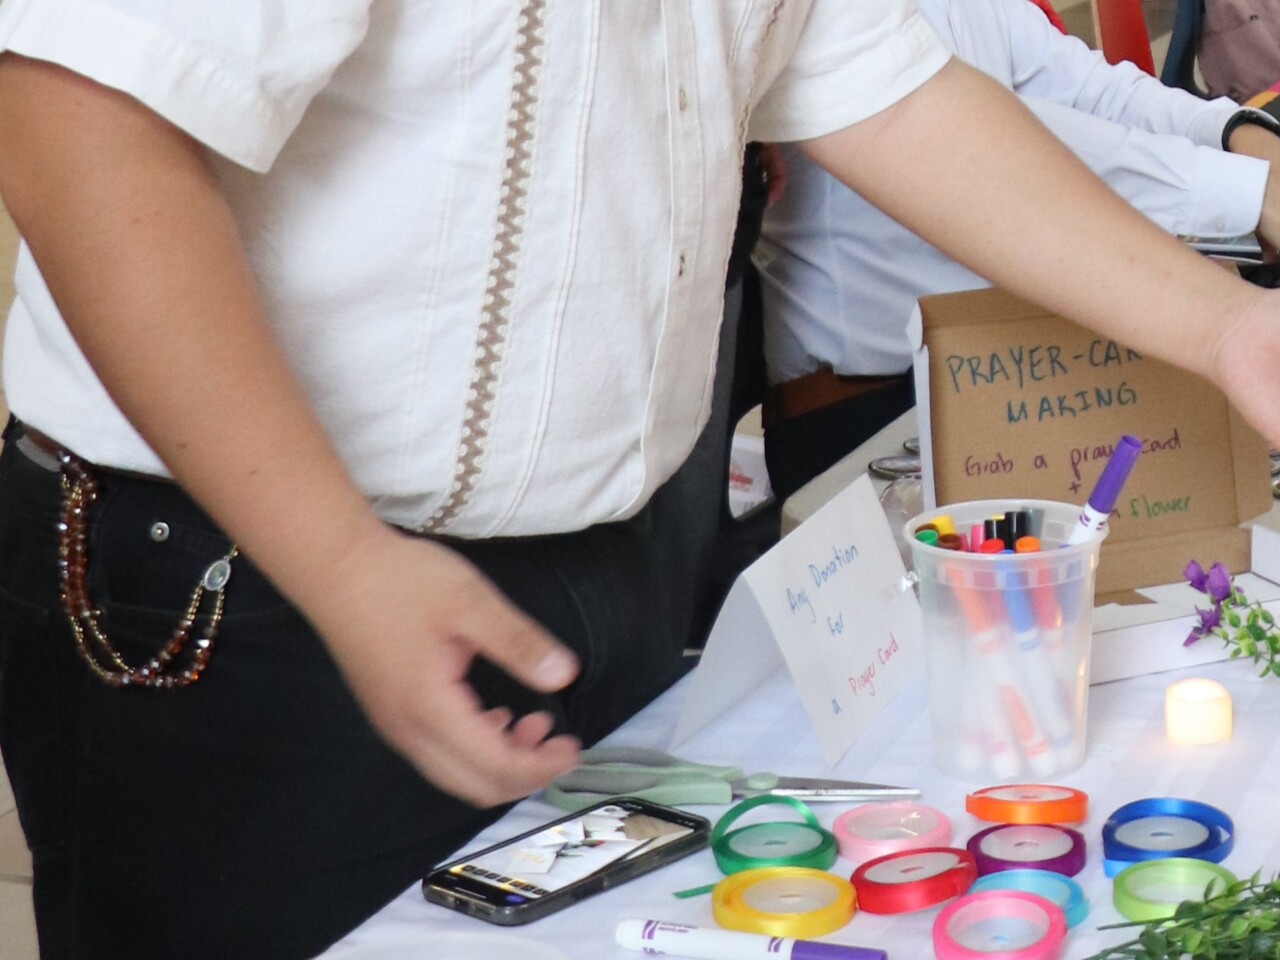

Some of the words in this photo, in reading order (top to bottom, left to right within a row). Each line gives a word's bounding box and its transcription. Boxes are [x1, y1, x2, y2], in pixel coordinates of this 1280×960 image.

[1007, 382, 1137, 423] MAKING
[965, 453, 1014, 476] Grab
[1034, 454, 1047, 469] a
[1130, 494, 1190, 518] flower
[787, 588, 816, 624] Any
[808, 545, 860, 587] Donation
[832, 698, 842, 714] a
[848, 663, 876, 696] Prayer
[878, 631, 900, 665] Card
